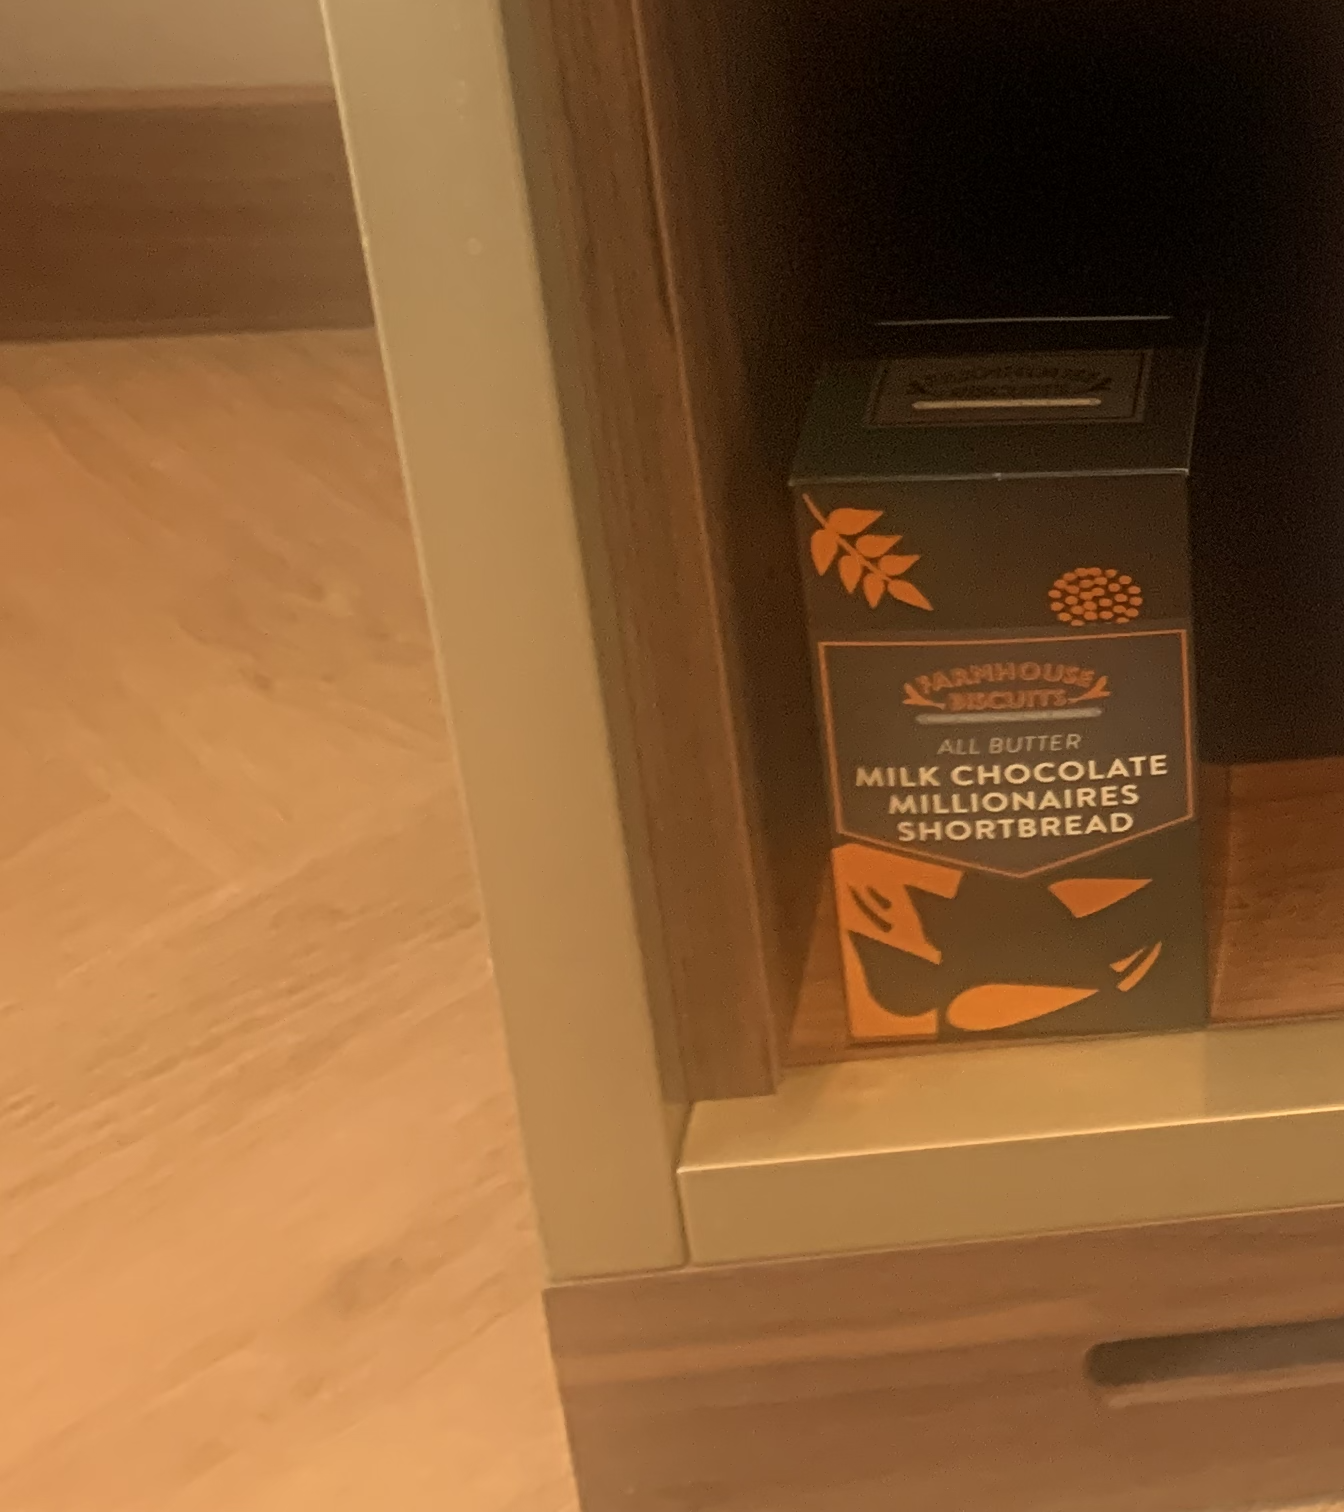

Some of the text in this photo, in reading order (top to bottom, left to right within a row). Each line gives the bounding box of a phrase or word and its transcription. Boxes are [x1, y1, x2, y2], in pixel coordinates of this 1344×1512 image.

[914, 662, 1096, 693] FARMHOUSE
[948, 689, 1067, 711] BISCUITS
[937, 733, 1082, 755] ALL BUTTER
[855, 754, 1169, 787] MILK CHOCOLATE
[888, 784, 1140, 815] MILLIONAIRES
[896, 811, 1134, 842] SHORTBREAD
